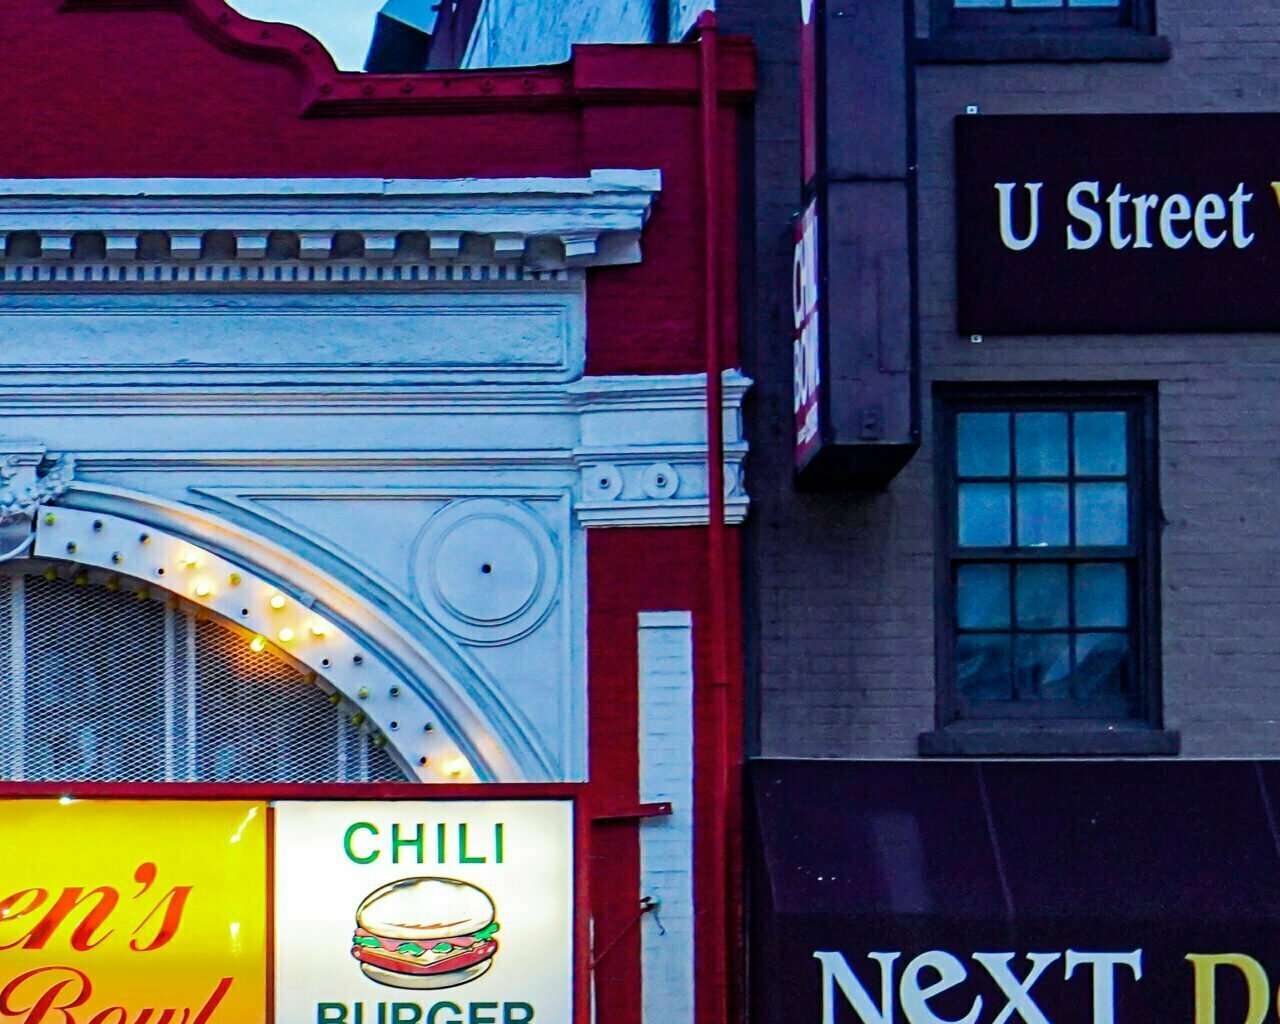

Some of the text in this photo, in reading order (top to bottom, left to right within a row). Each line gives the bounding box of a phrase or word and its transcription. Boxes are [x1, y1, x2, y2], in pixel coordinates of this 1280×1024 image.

[993, 181, 1043, 252] U
[1065, 180, 1255, 251] Street
[342, 821, 506, 865] CHILI
